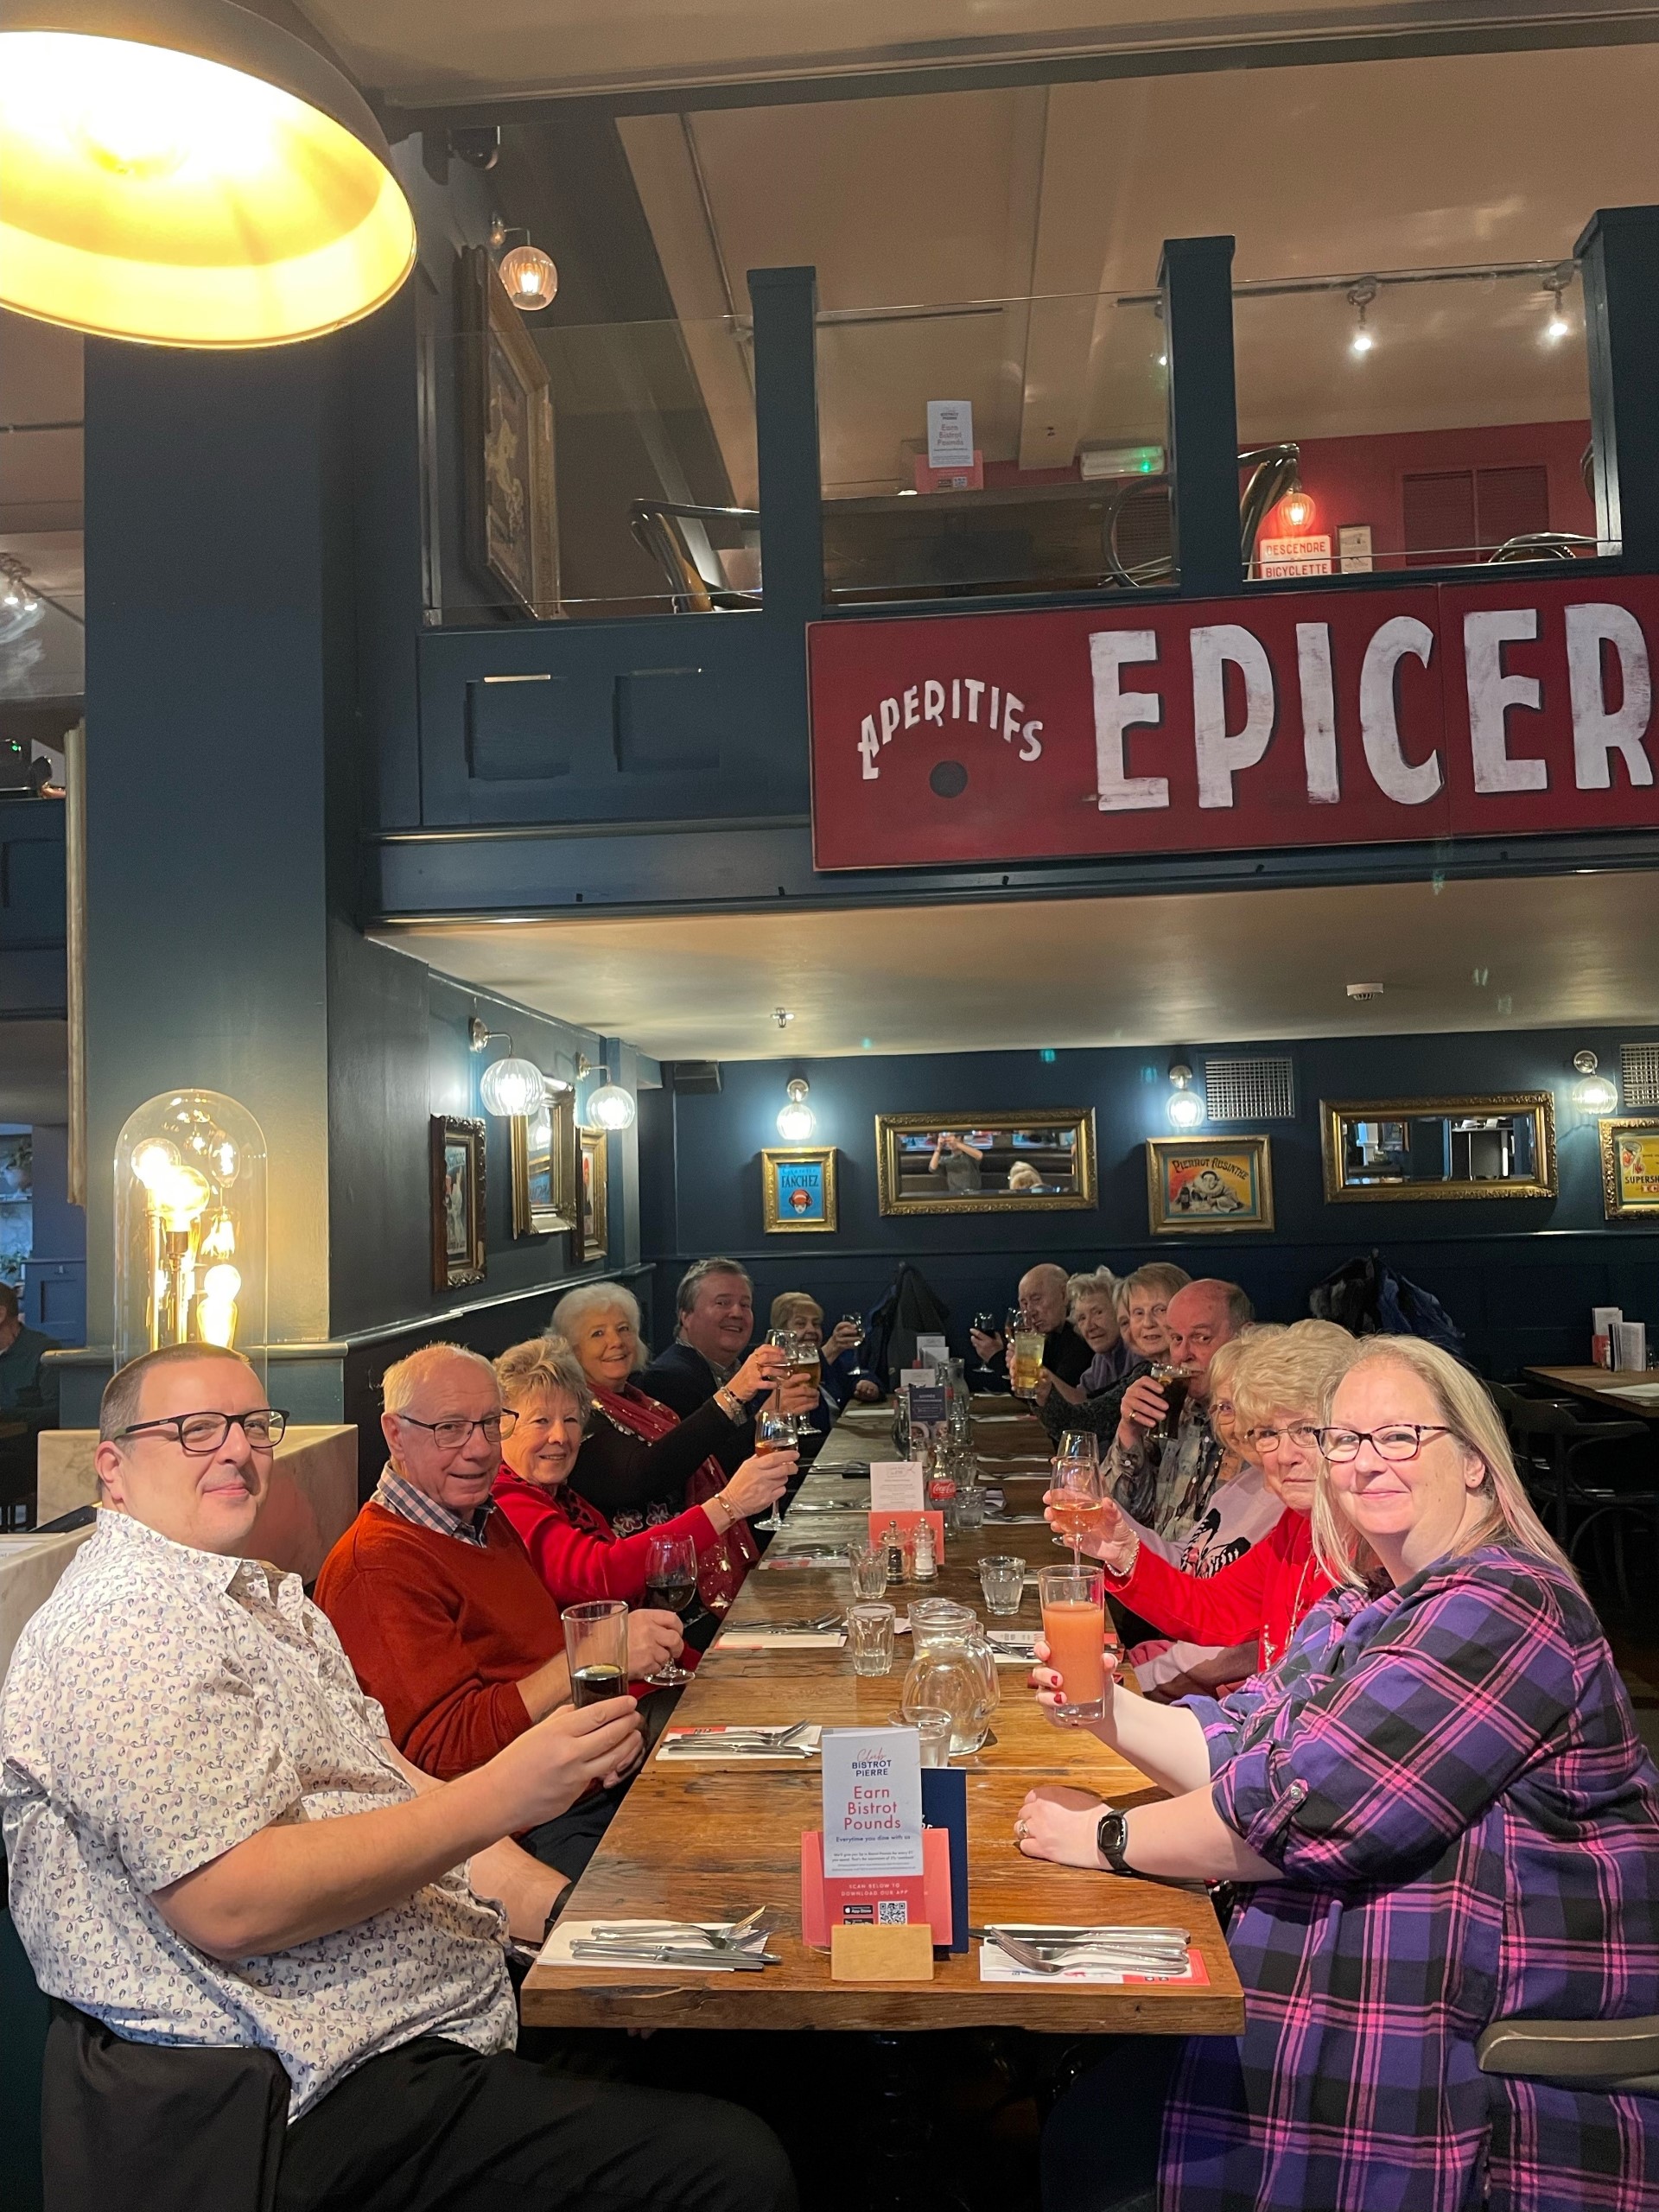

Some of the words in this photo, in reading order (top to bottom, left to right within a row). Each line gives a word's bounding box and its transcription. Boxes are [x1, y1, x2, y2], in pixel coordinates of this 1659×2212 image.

[1266, 541, 1326, 556] DESCENDRE
[1265, 563, 1328, 578] BICYCLETTE
[1088, 602, 1654, 812] EPICER
[856, 678, 1044, 780] APERITIFS
[851, 1759, 892, 1770] BISTROT
[855, 1768, 889, 1777] PIERRE
[854, 1785, 890, 1799] Earn
[848, 1802, 897, 1815] Bistrot
[844, 1815, 901, 1830] Pounds
